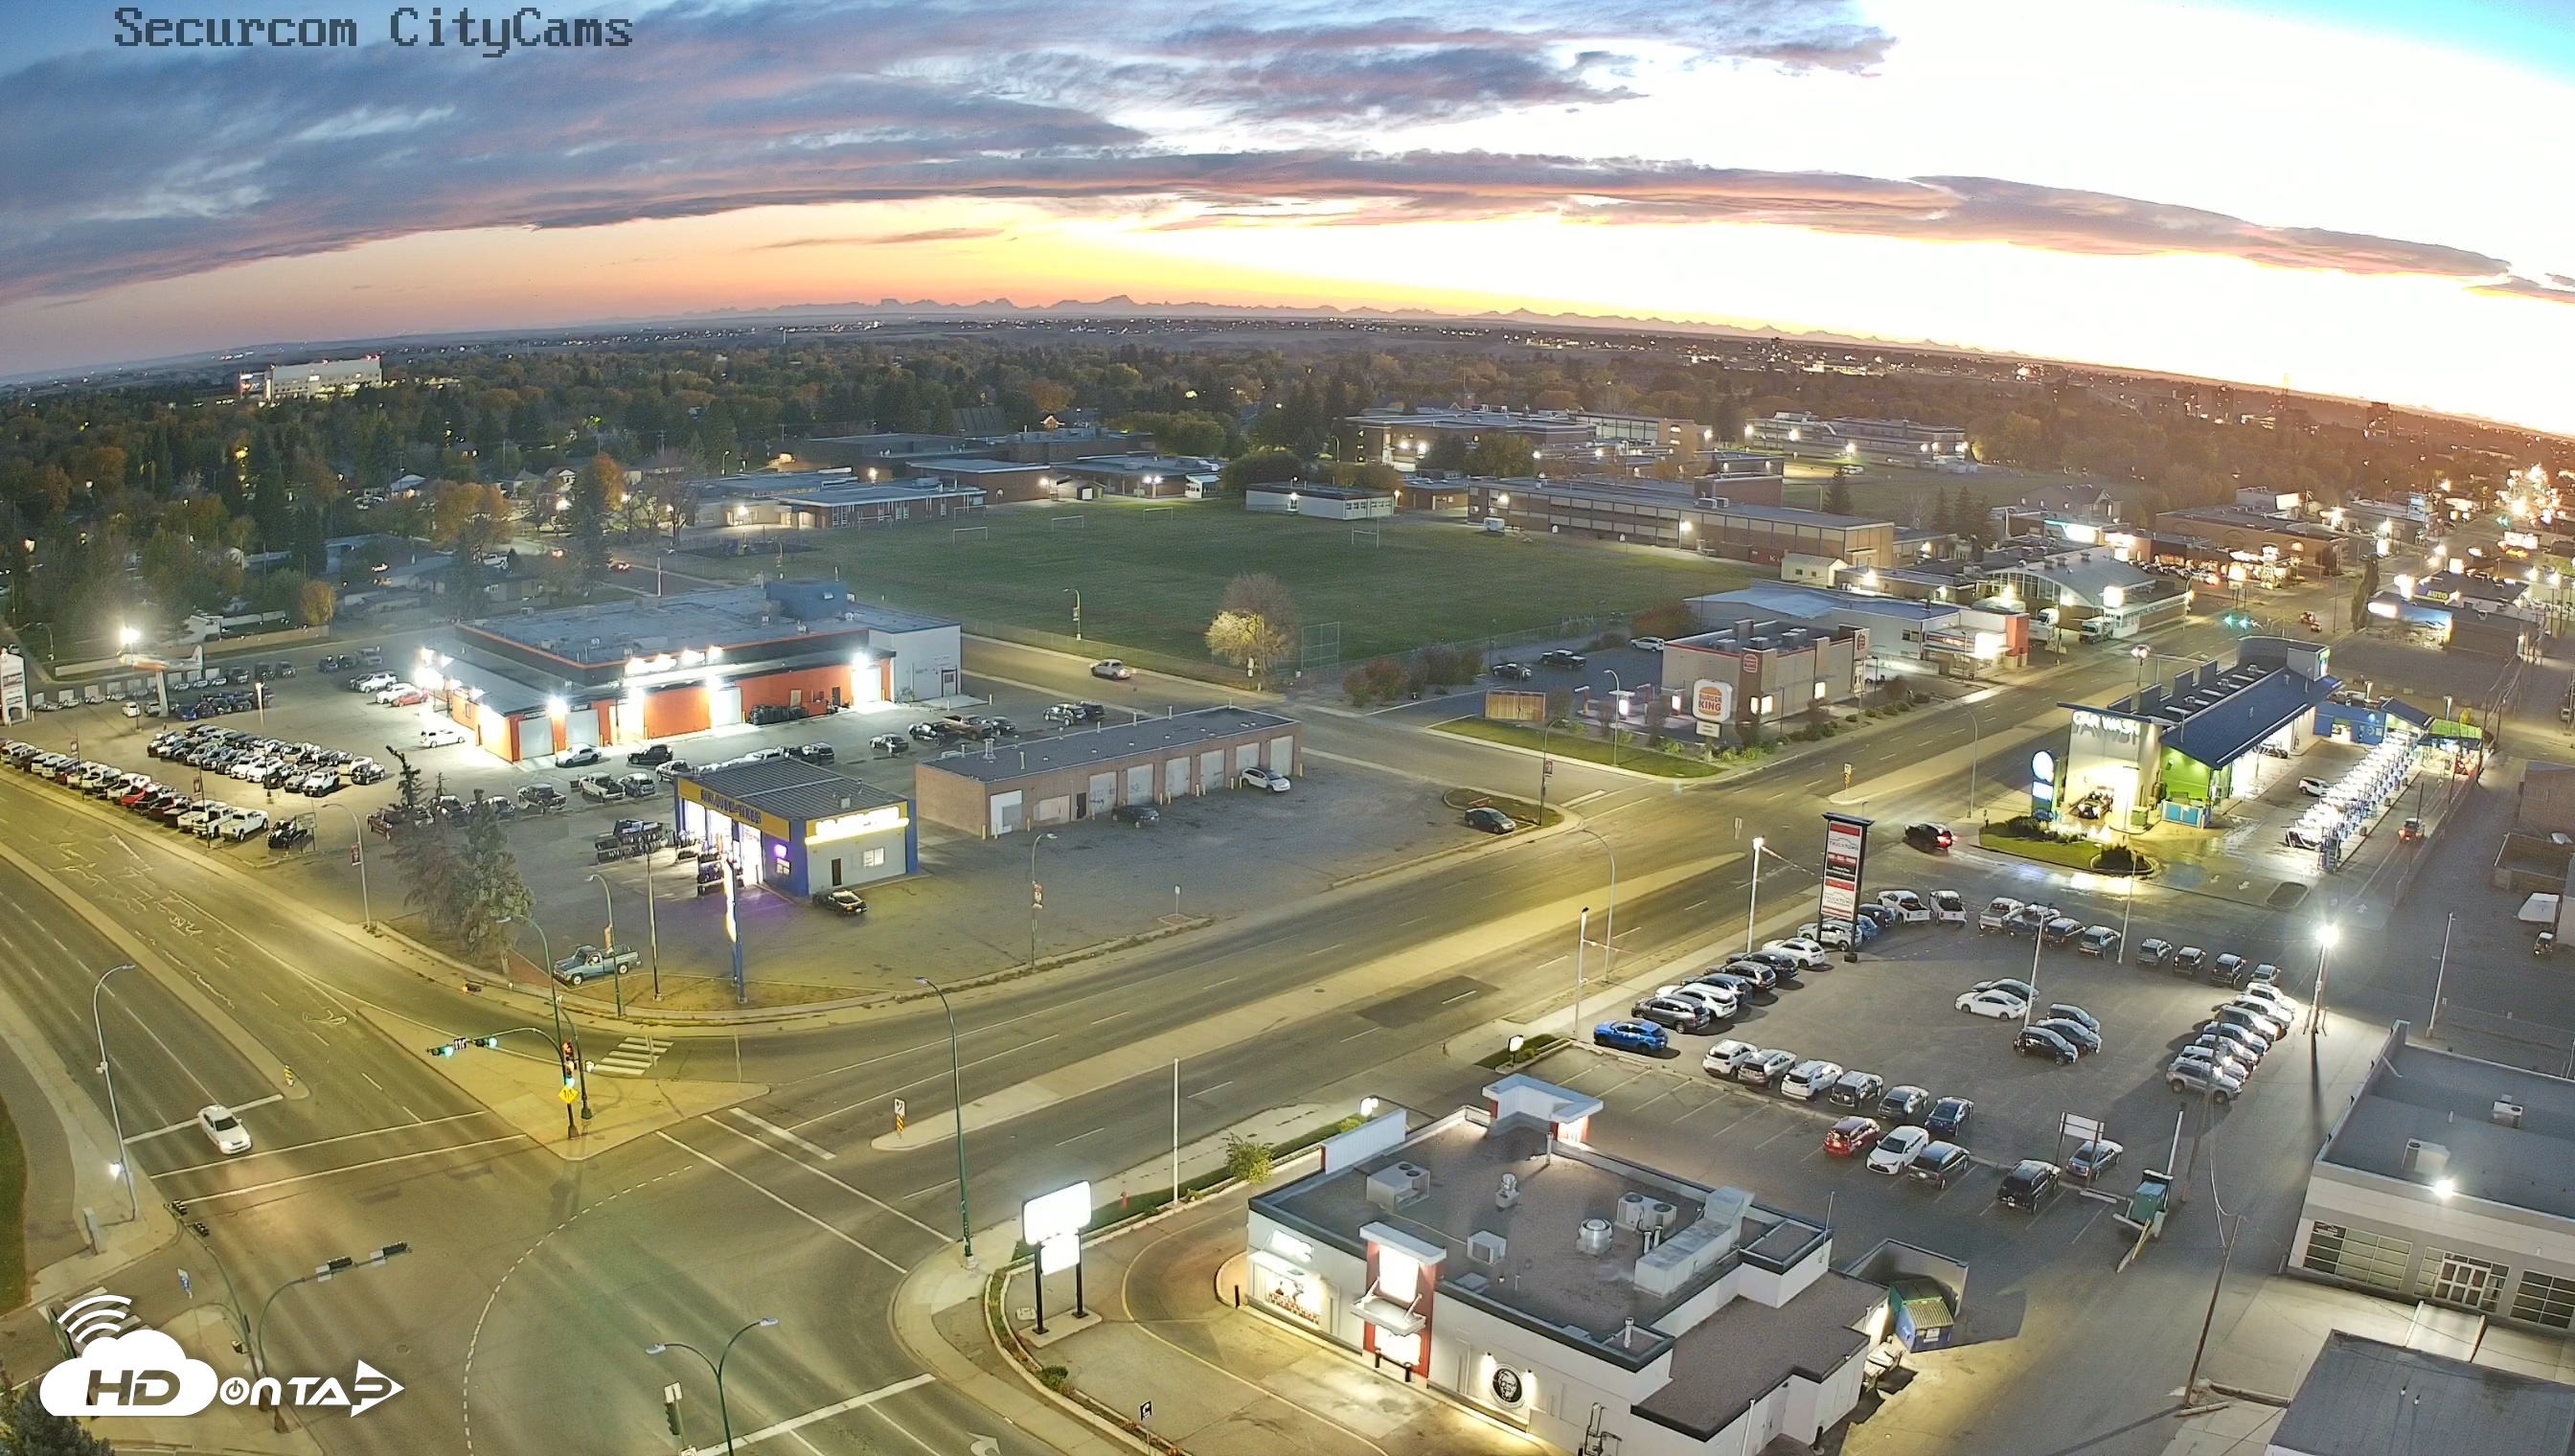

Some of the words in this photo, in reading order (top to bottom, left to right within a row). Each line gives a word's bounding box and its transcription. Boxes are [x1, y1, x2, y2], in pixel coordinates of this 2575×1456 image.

[2426, 589, 2449, 600] AUTO
[1698, 693, 1722, 703] BURGER
[1698, 699, 1721, 712] KING
[2101, 716, 2141, 737] WASH
